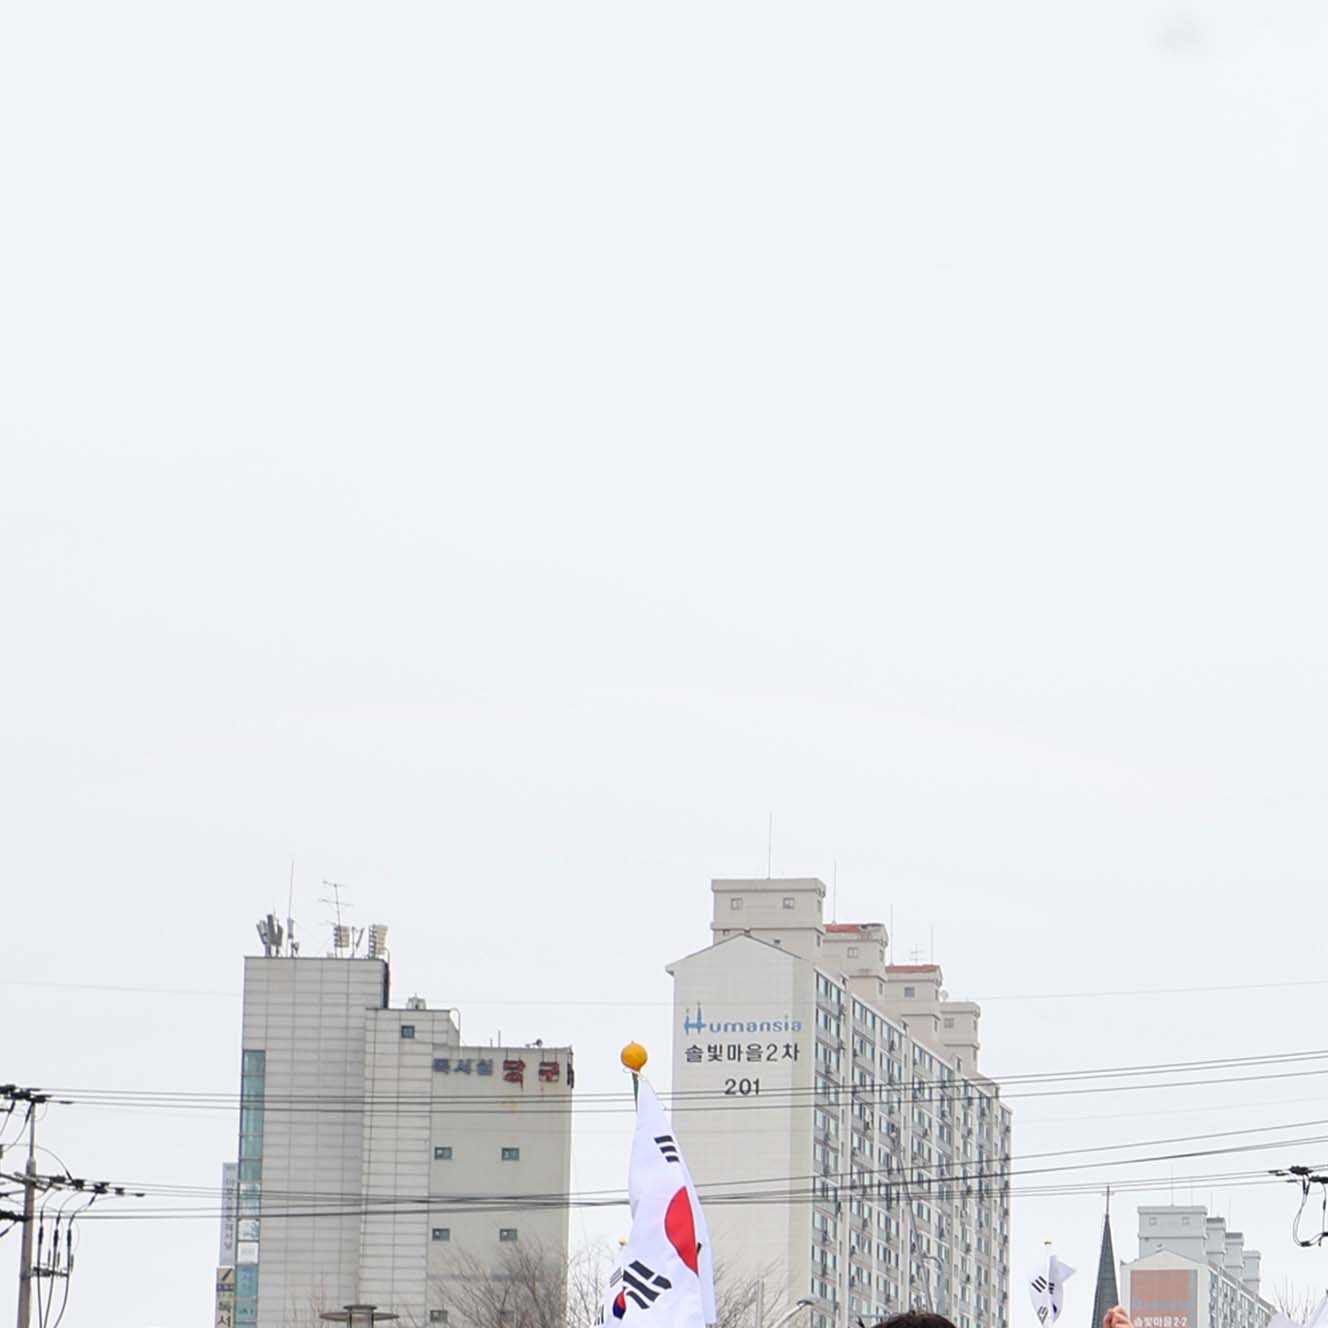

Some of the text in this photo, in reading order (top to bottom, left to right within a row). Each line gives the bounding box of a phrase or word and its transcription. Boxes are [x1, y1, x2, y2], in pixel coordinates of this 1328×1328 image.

[684, 1001, 802, 1036] Humansia
[685, 1043, 801, 1063] 솔빛마을2차
[724, 1078, 760, 1096] 201
